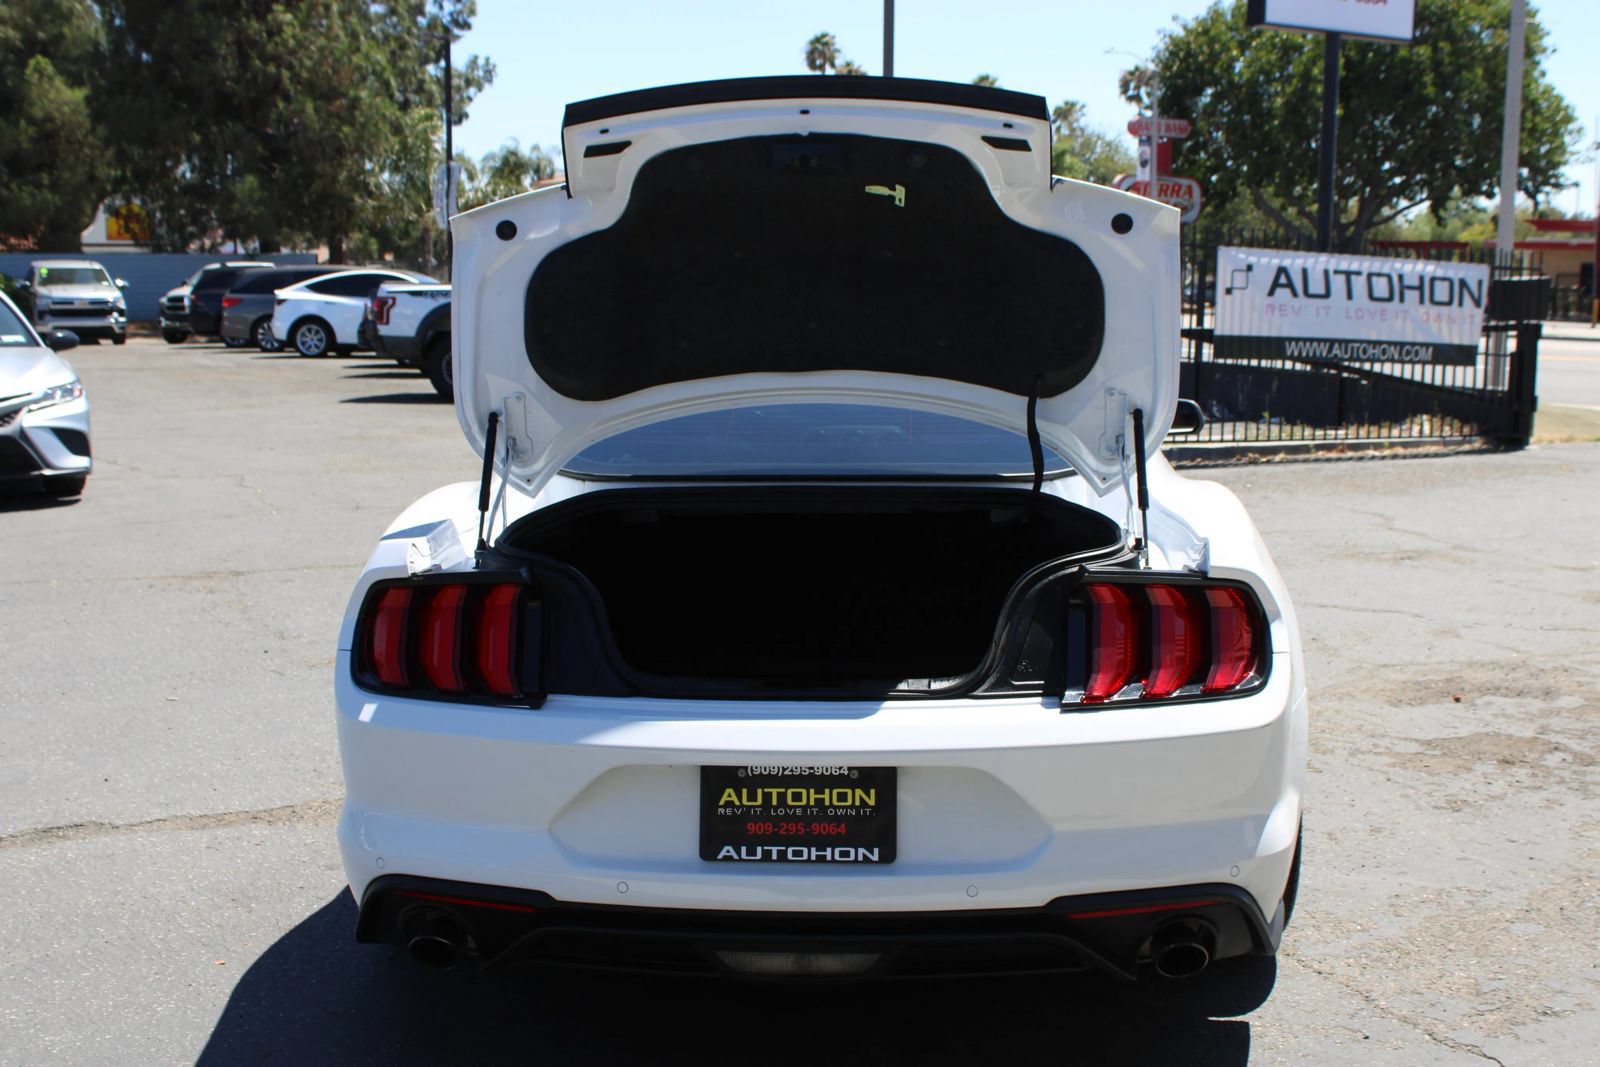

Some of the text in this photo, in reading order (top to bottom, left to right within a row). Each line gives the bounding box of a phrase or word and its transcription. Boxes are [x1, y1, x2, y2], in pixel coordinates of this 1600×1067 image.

[1267, 266, 1484, 308] AUTOHON
[1344, 306, 1389, 322] LOVE
[1286, 340, 1433, 362] WWW.AUTOHON.COM
[718, 788, 876, 806] AUTOHON
[771, 808, 802, 816] LOVE
[827, 808, 856, 816] OWN
[746, 822, 847, 836] 909-295-9064
[716, 845, 880, 862] AUTOHON
